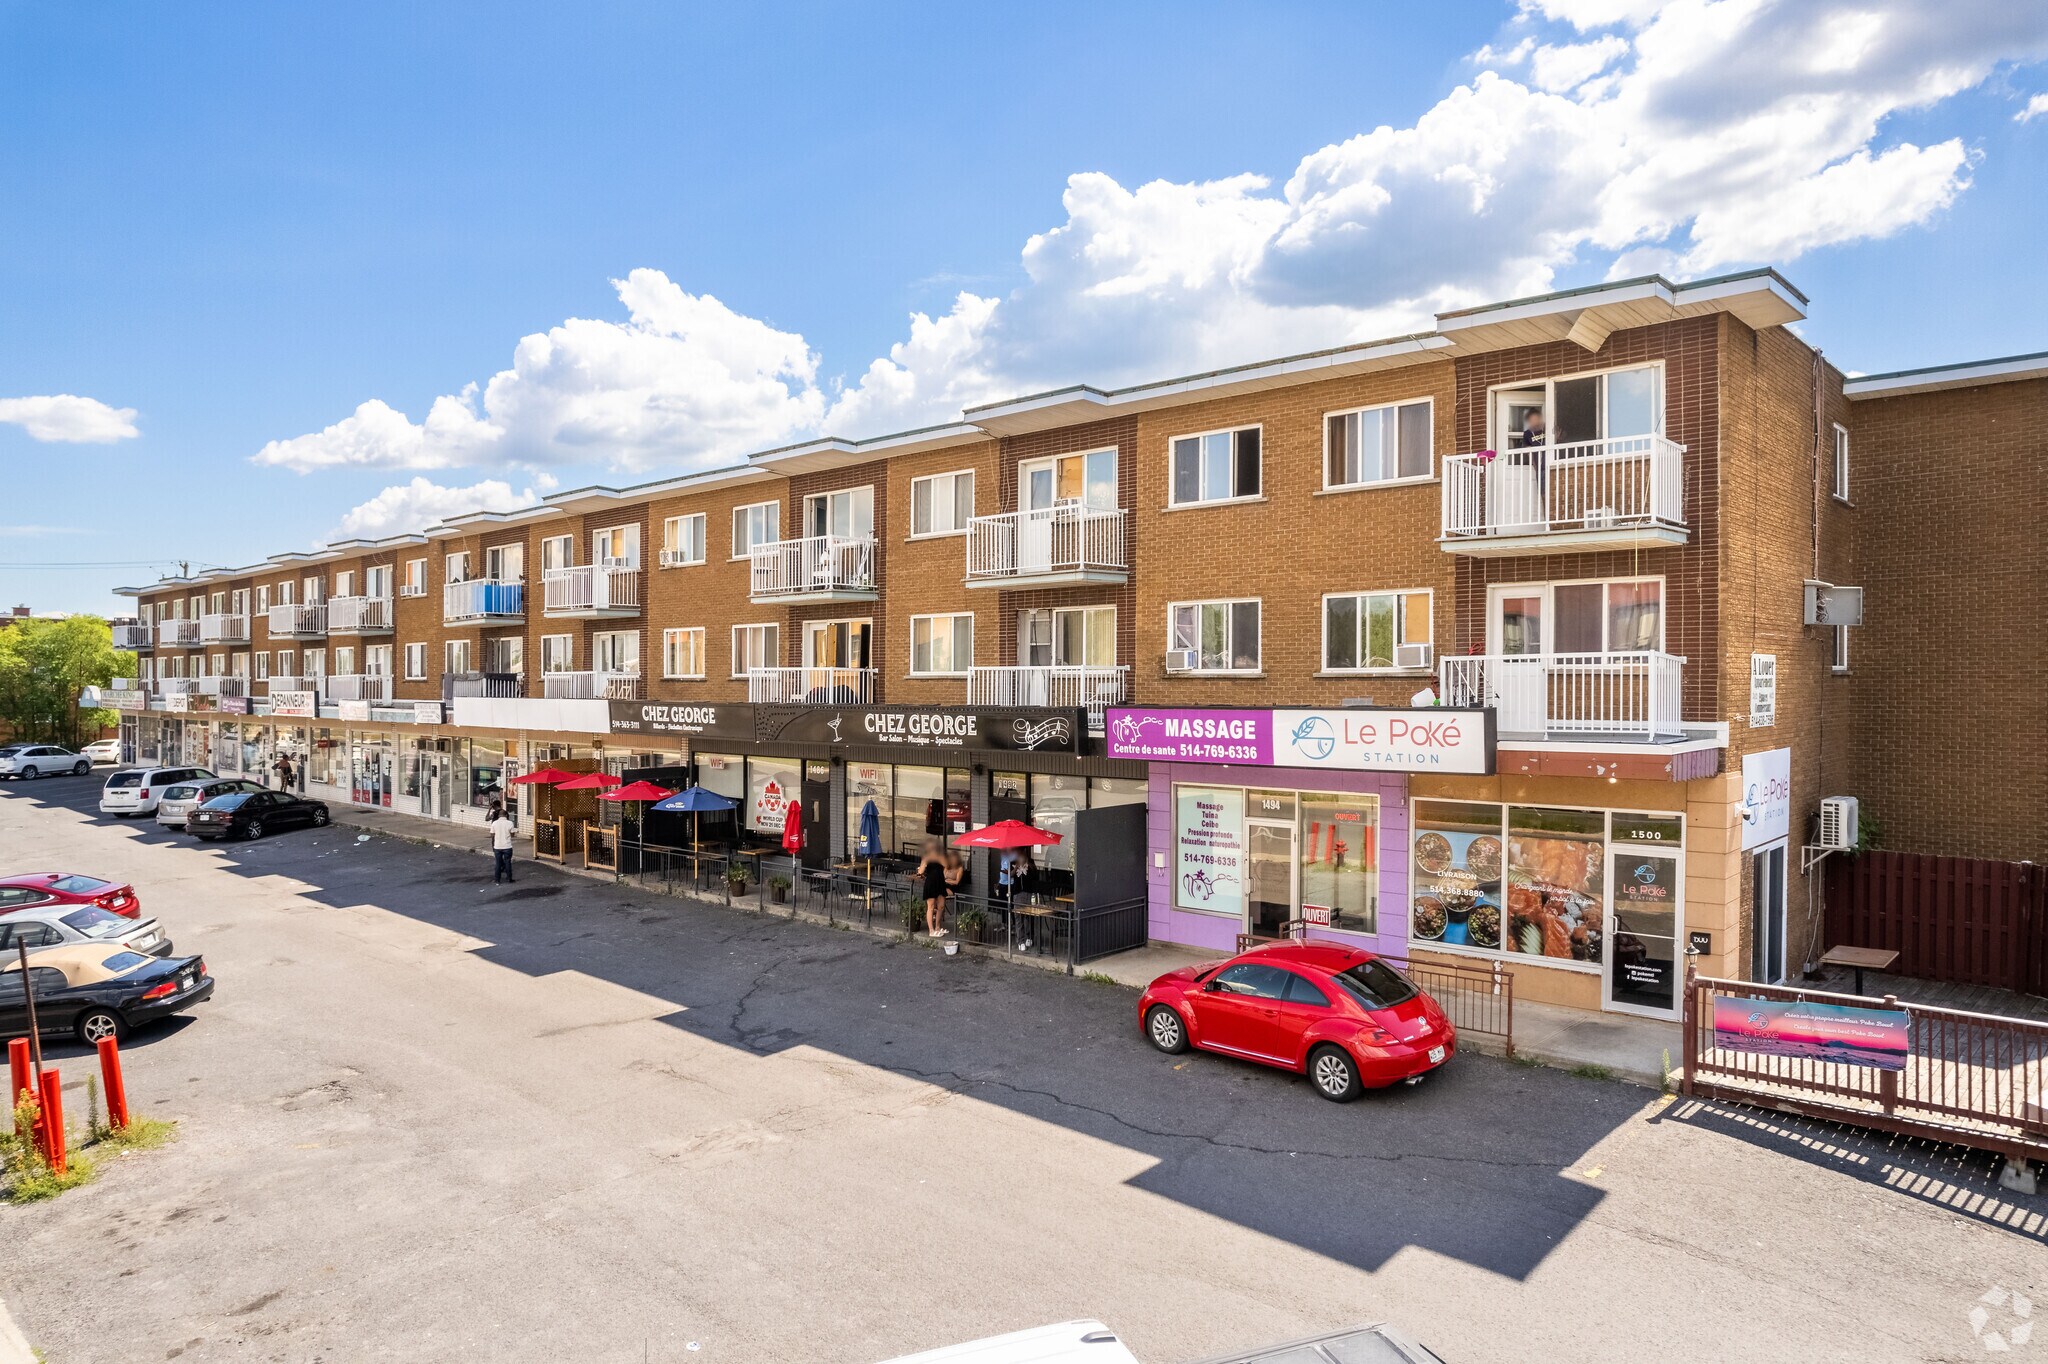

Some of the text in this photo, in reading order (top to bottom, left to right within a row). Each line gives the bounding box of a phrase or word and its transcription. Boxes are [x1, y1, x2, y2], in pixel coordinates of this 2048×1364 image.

[641, 705, 716, 724] CHEZ GEORGE
[864, 713, 978, 736] CHEZ GEORGE
[1165, 718, 1256, 740] MASSAGE
[1344, 718, 1462, 748] Le Poké
[889, 734, 903, 743] Salon
[907, 735, 930, 746] Musique
[935, 736, 963, 746] Spectacles
[1113, 743, 1258, 759] Centre de sante 514-769-6336
[710, 757, 725, 768] WIFI
[1363, 752, 1440, 764] STATION
[809, 765, 825, 775] 1486
[860, 768, 878, 781] WIFI
[1760, 781, 1769, 806] Le
[1196, 801, 1224, 812] Massage
[1261, 799, 1281, 810] 1494
[1201, 810, 1219, 820] Tuina
[1334, 812, 1361, 821] OUVERT
[1187, 828, 1210, 838] Pression
[1631, 830, 1662, 840] 1500
[1180, 836, 1207, 847] Relaxation
[1184, 852, 1237, 867] 514-769-6336
[1437, 870, 1478, 881] LIVRAISON
[1623, 883, 1636, 895] Le
[1303, 907, 1329, 924] OUVERT
[1738, 1026, 1751, 1038] Le
